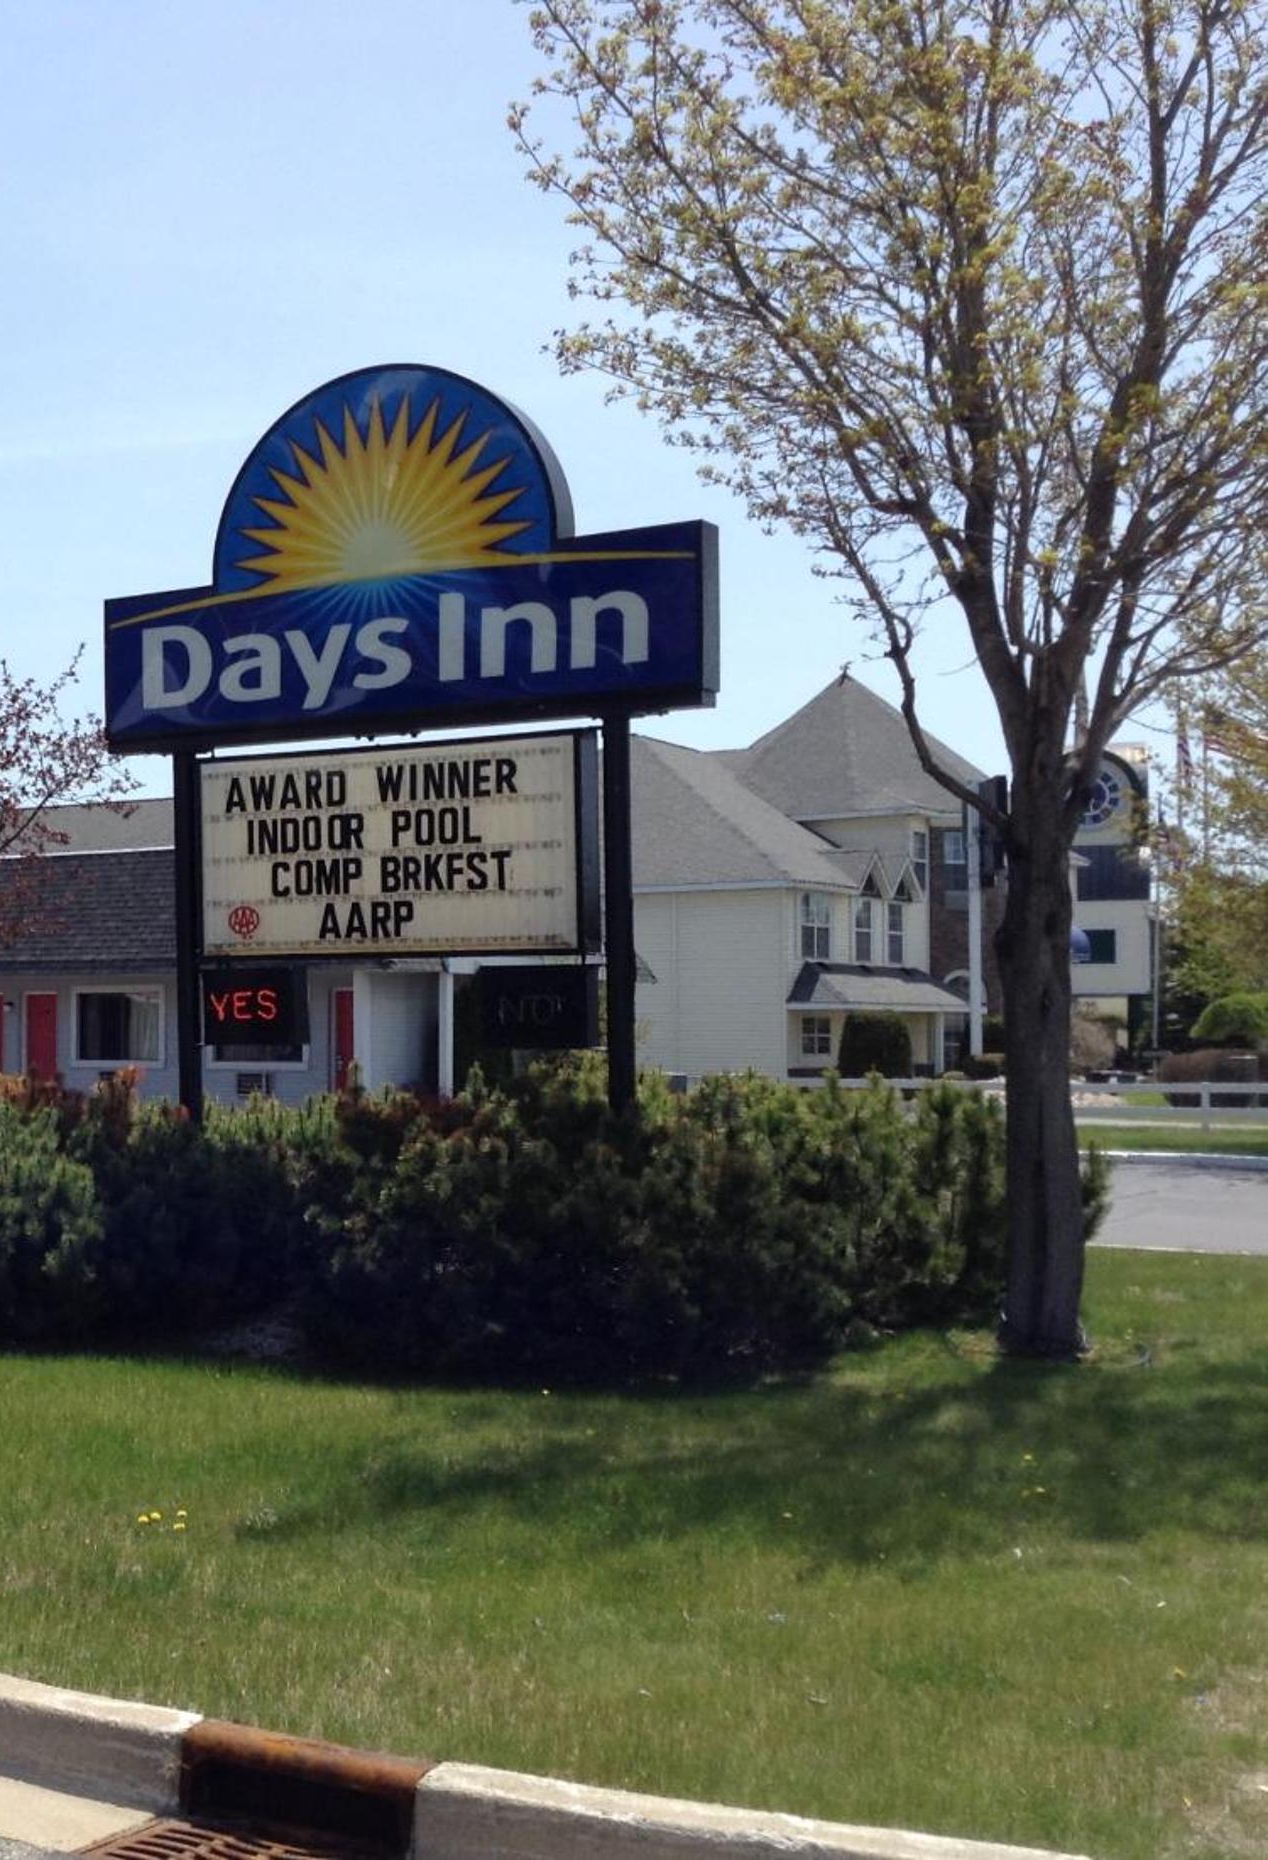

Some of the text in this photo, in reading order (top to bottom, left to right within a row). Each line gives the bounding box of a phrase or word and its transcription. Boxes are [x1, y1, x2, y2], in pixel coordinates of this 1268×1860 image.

[142, 590, 649, 710] Days Inn
[225, 758, 518, 813] AWARD WINNER
[247, 806, 482, 855] INDOOR POOL
[271, 850, 512, 897] COMP BRKFST
[319, 900, 415, 940] AARP
[210, 989, 278, 1021] YES
